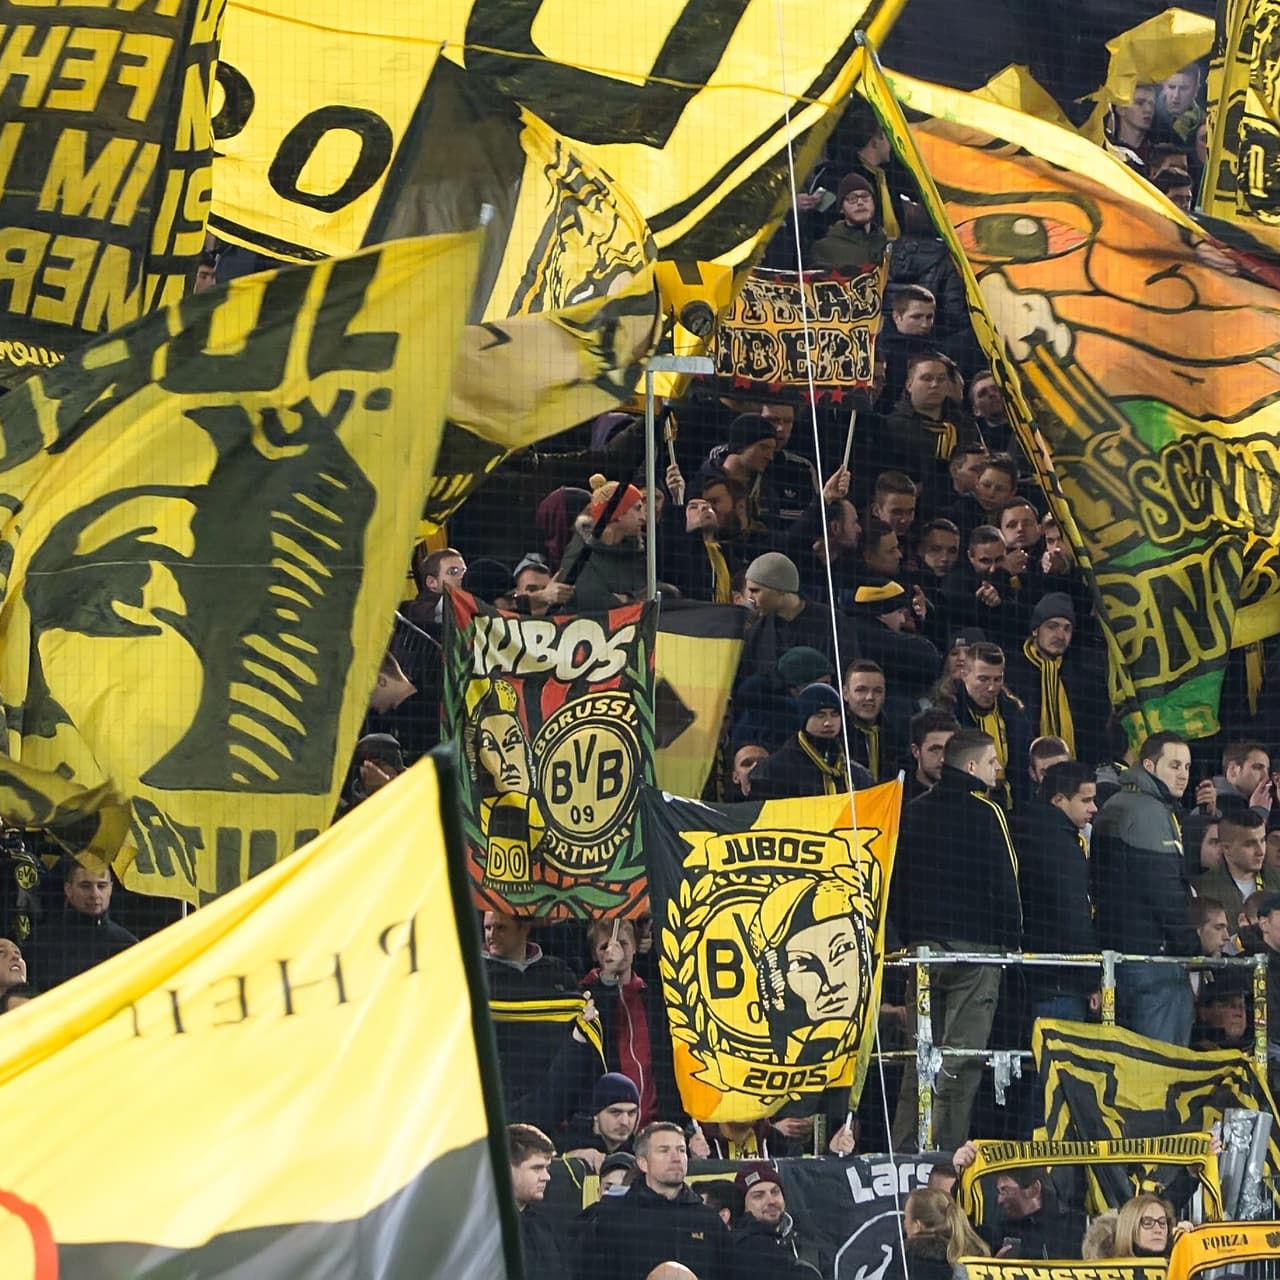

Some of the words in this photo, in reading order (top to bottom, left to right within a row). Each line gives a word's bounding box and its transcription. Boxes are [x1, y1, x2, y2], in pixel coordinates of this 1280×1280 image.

[550, 733, 625, 806] BVB
[570, 803, 596, 827] 09
[490, 847, 528, 876] DO
[721, 837, 825, 866] JUBOS
[742, 1065, 829, 1093] 2005
[1200, 1232, 1251, 1253] FORZA
